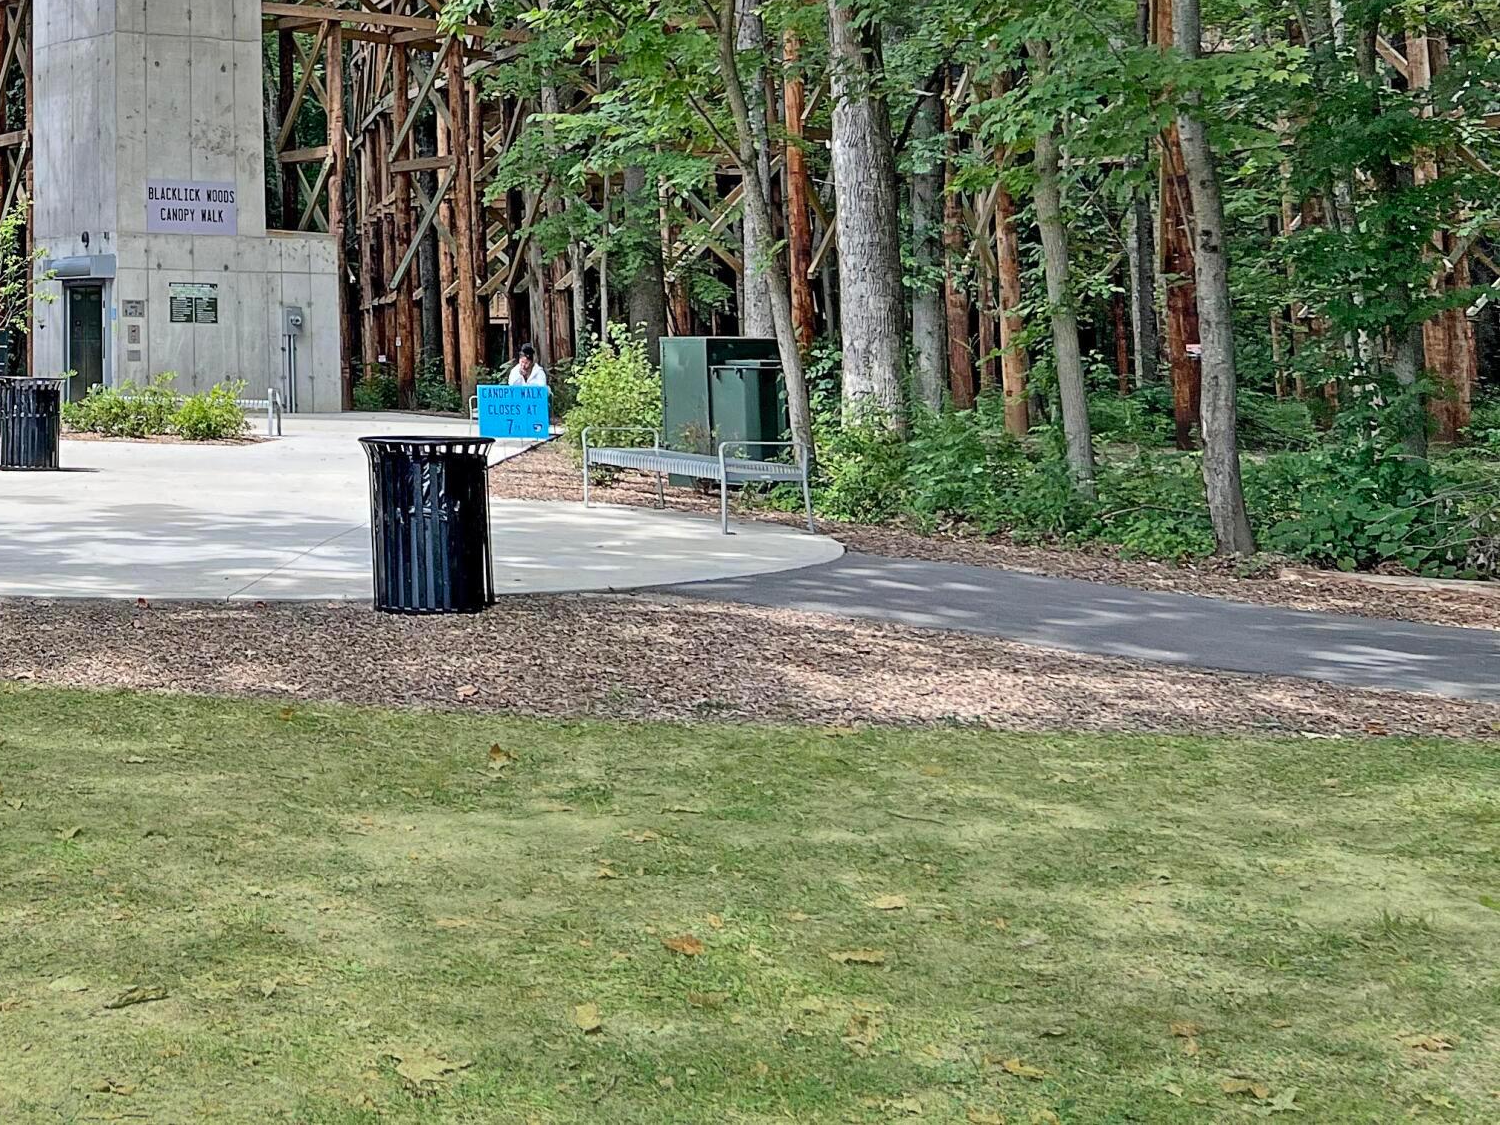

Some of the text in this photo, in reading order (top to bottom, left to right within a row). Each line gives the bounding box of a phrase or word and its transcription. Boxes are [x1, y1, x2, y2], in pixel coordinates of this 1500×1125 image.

[148, 187, 235, 204] BLACKLICK WOODS
[160, 208, 224, 223] CANOPY WALK
[482, 388, 543, 399] CANOPY WALK
[488, 404, 537, 415] CLOSES AT
